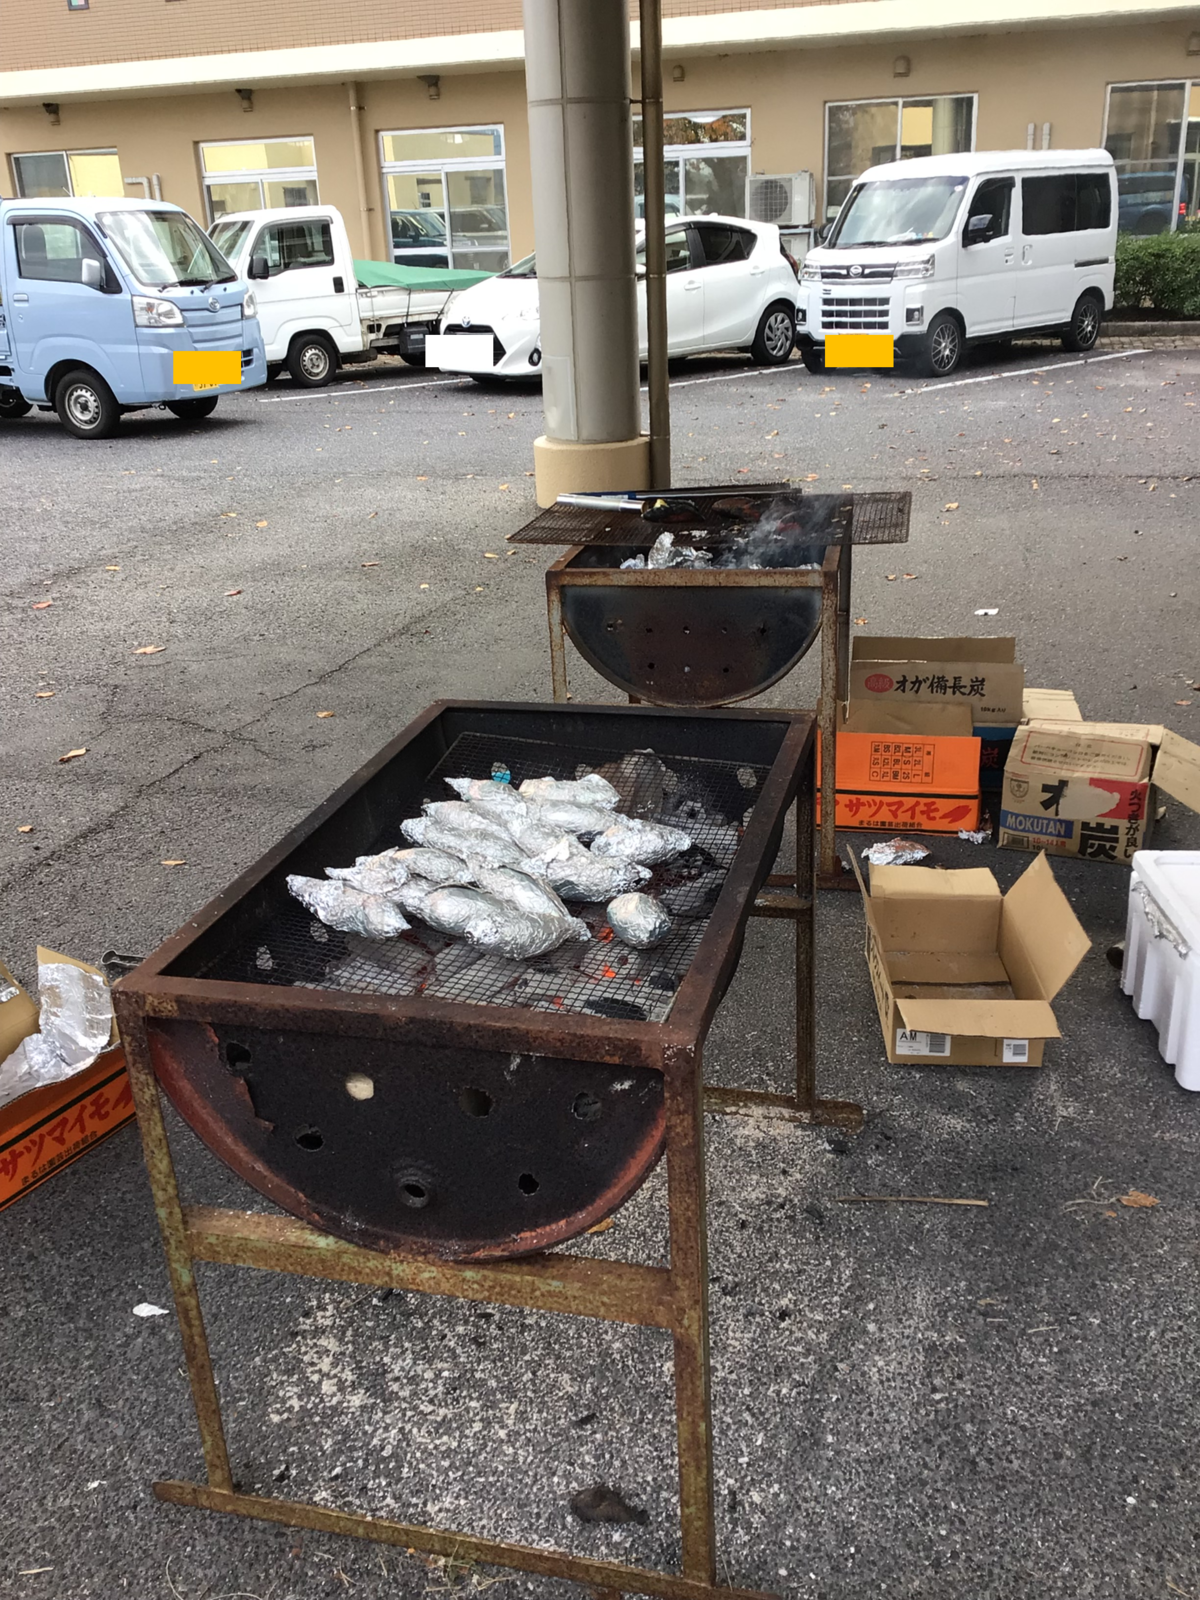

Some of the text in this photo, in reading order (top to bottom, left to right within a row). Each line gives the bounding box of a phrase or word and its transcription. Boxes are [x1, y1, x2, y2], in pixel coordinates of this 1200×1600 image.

[894, 674, 986, 697] オガ備長炭
[871, 770, 879, 778] C
[902, 771, 910, 780] 2S
[844, 797, 940, 821] サツマイモ
[1006, 813, 1065, 836] MOKUTAN
[1078, 821, 1119, 860] 炭
[0, 1091, 110, 1182] サツマイモ
